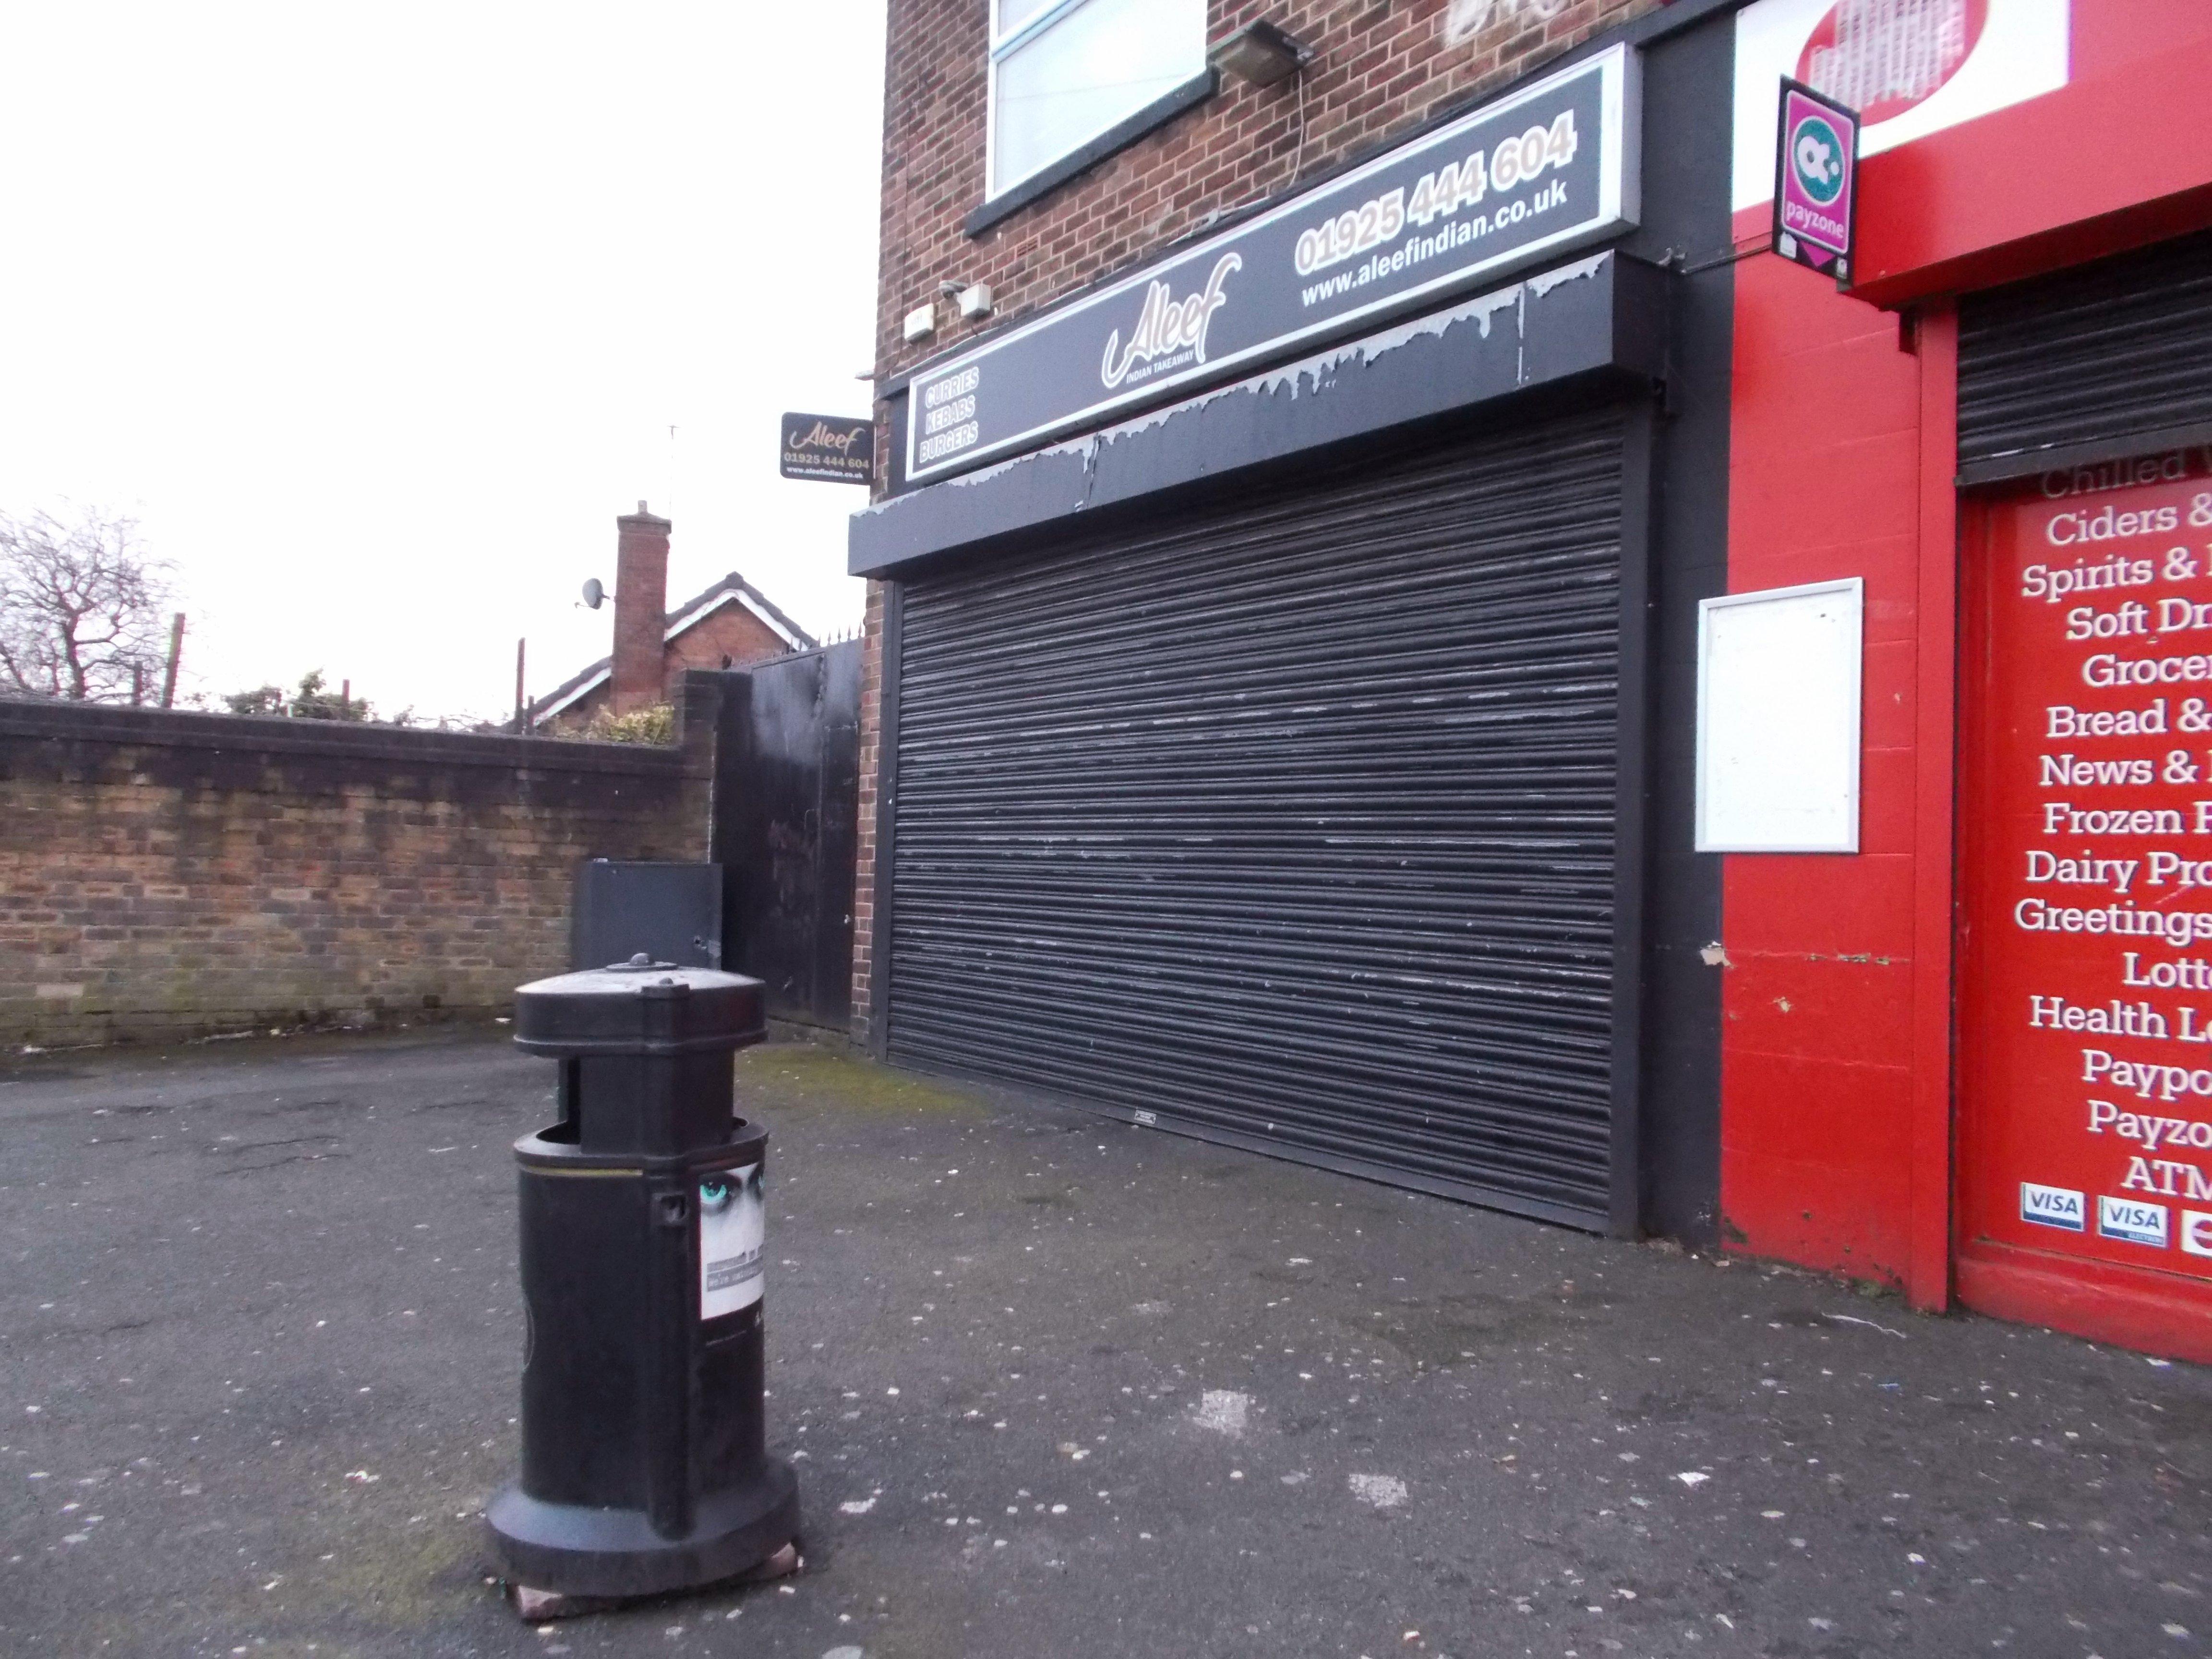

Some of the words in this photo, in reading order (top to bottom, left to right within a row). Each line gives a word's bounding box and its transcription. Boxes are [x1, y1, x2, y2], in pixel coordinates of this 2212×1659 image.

[1295, 186, 1405, 276] 01925
[1407, 151, 1487, 227] 444
[1491, 109, 1577, 191] 604
[1787, 201, 1844, 239] payzone
[1301, 179, 1567, 308] www.aleefindian.co.uk
[1101, 252, 1242, 388] Aleef
[926, 366, 979, 408] CURRIES
[1126, 366, 1152, 384] INDIAN
[1153, 349, 1194, 373] TAKEAWAY
[926, 395, 975, 434] KEBABS
[790, 421, 866, 456] Aleef
[920, 421, 978, 463] BURGERS
[784, 452, 820, 464] 01925
[823, 456, 845, 467] 444
[848, 458, 869, 469] 604
[2041, 452, 2187, 498] Chilled
[2046, 505, 2178, 546] Ciders
[2188, 492, 2212, 527] &
[2021, 554, 2153, 604] Spirits
[2162, 546, 2198, 581] &
[2066, 601, 2148, 640] Soft
[2082, 654, 2212, 687] Groce
[2046, 698, 2168, 738] Bread
[2177, 698, 2212, 733] &
[2039, 754, 2153, 786] News
[2162, 750, 2199, 784] &
[2043, 803, 2184, 834] Frozen
[2025, 849, 2139, 894] Dairy
[2015, 898, 2212, 947] Greetings
[2122, 952, 2212, 990] Lott
[2029, 995, 2169, 1039] Health
[2176, 1007, 2212, 1043] L
[2087, 1099, 2212, 1151] Payzo
[2120, 1156, 2212, 1201] ATM
[2030, 1190, 2079, 1215] VISA
[2109, 1203, 2161, 1230] VISA
